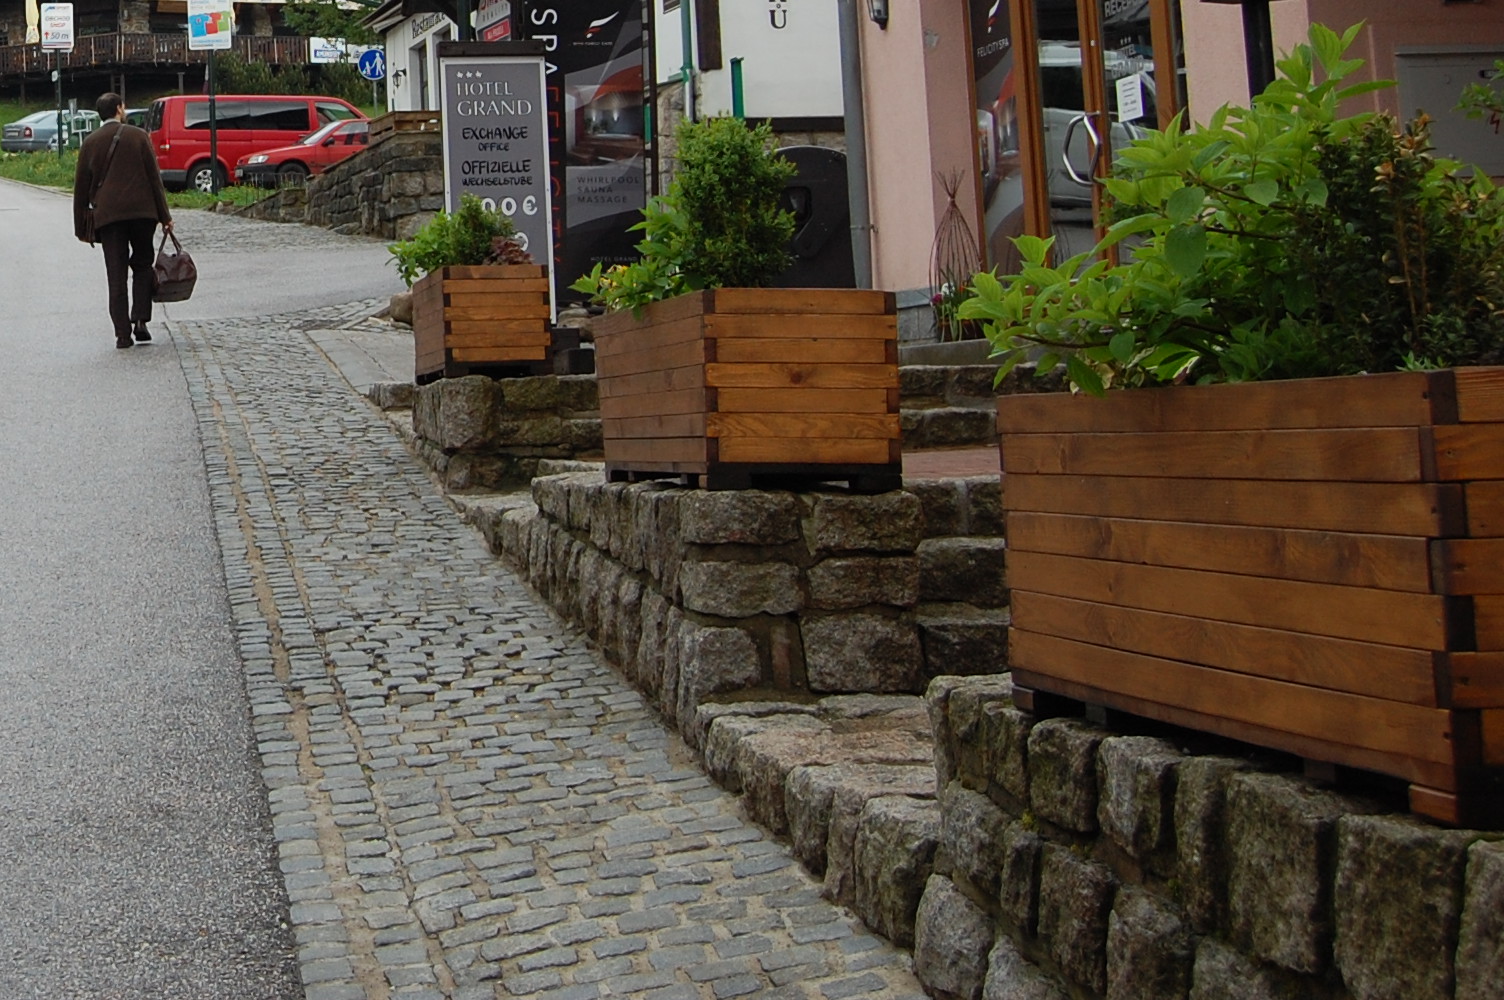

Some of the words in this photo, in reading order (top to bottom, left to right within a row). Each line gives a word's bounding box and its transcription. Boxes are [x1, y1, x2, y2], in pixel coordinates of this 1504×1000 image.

[50, 31, 61, 40] 50
[456, 81, 513, 97] HOTEL
[457, 99, 532, 117] GRAND
[462, 126, 528, 141] EXCHANGE
[478, 142, 510, 152] OFFICE
[461, 159, 532, 175] OFFIZIELLE
[577, 176, 639, 184] WHIRLPOOL
[577, 195, 627, 203] MASSAGE
